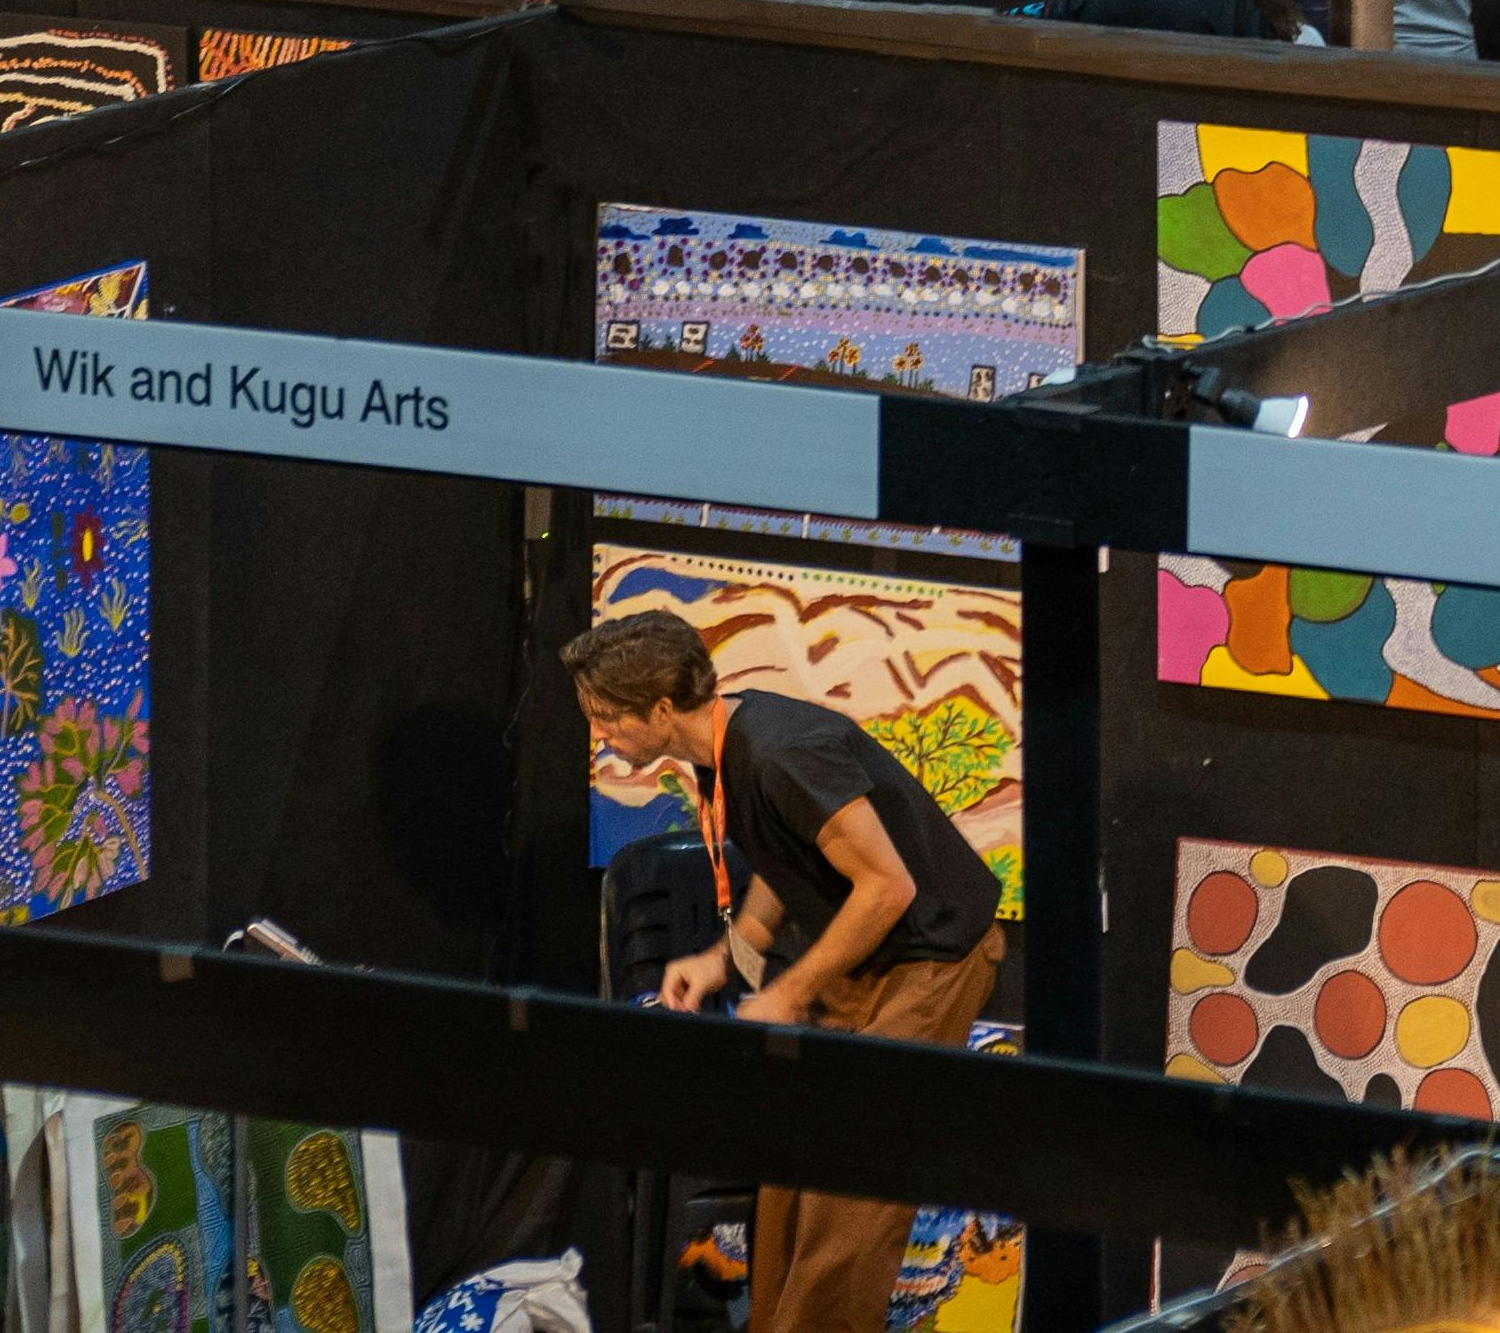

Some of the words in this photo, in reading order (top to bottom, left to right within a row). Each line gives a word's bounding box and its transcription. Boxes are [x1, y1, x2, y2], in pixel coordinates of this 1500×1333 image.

[33, 346, 115, 398] Wik
[130, 362, 212, 407] and
[230, 365, 345, 429] Kugu
[359, 379, 449, 431] Arts
